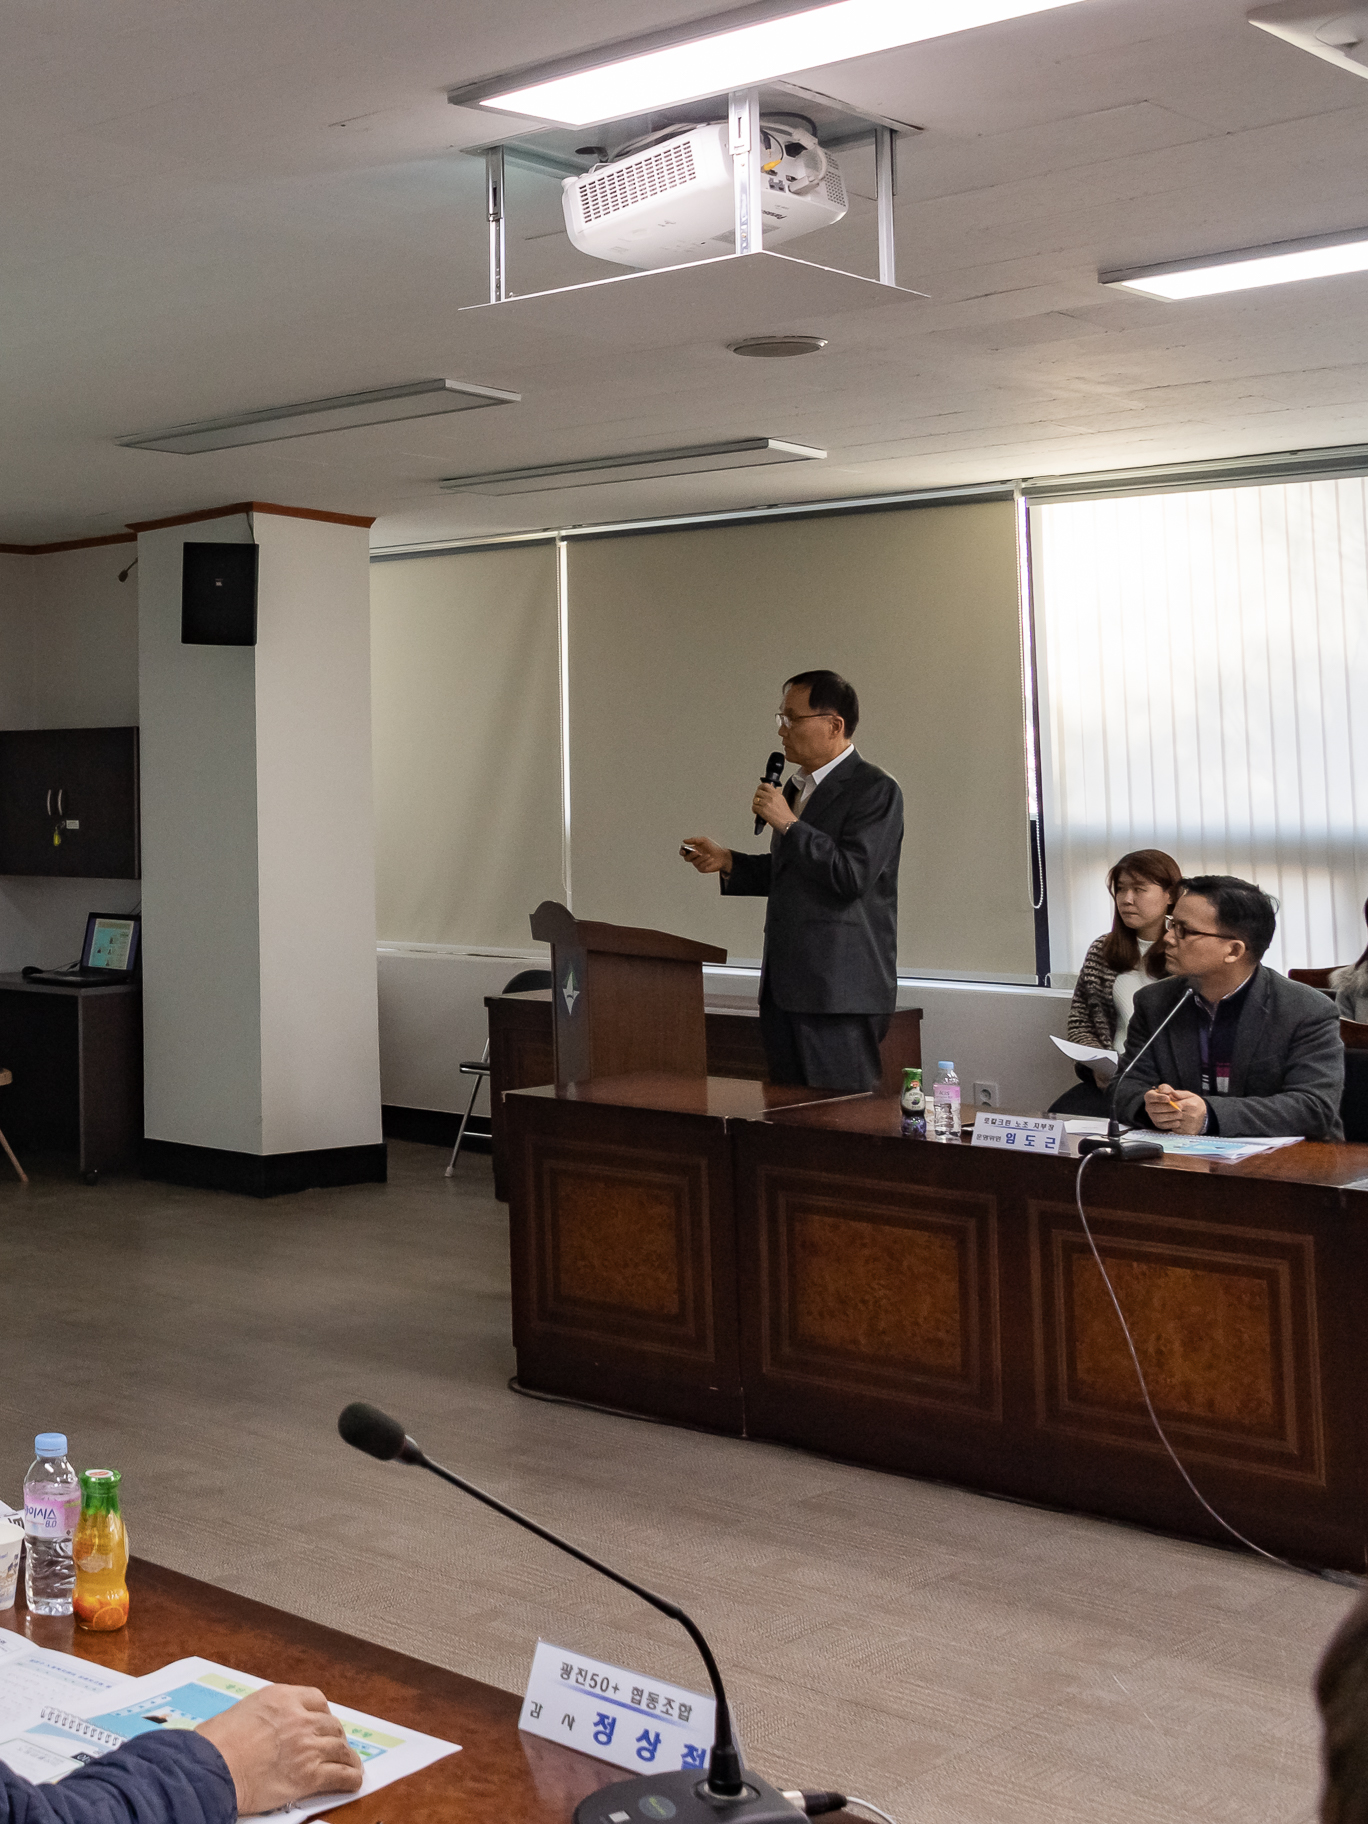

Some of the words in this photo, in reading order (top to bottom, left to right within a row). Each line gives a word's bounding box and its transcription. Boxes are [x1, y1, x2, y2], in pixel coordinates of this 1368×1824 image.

[1014, 1120, 1029, 1129] 노조
[1032, 1122, 1055, 1132] 지부장
[44, 1519, 57, 1529] 8.0
[559, 1661, 620, 1695] 광진50+
[630, 1685, 693, 1723] 협동조합
